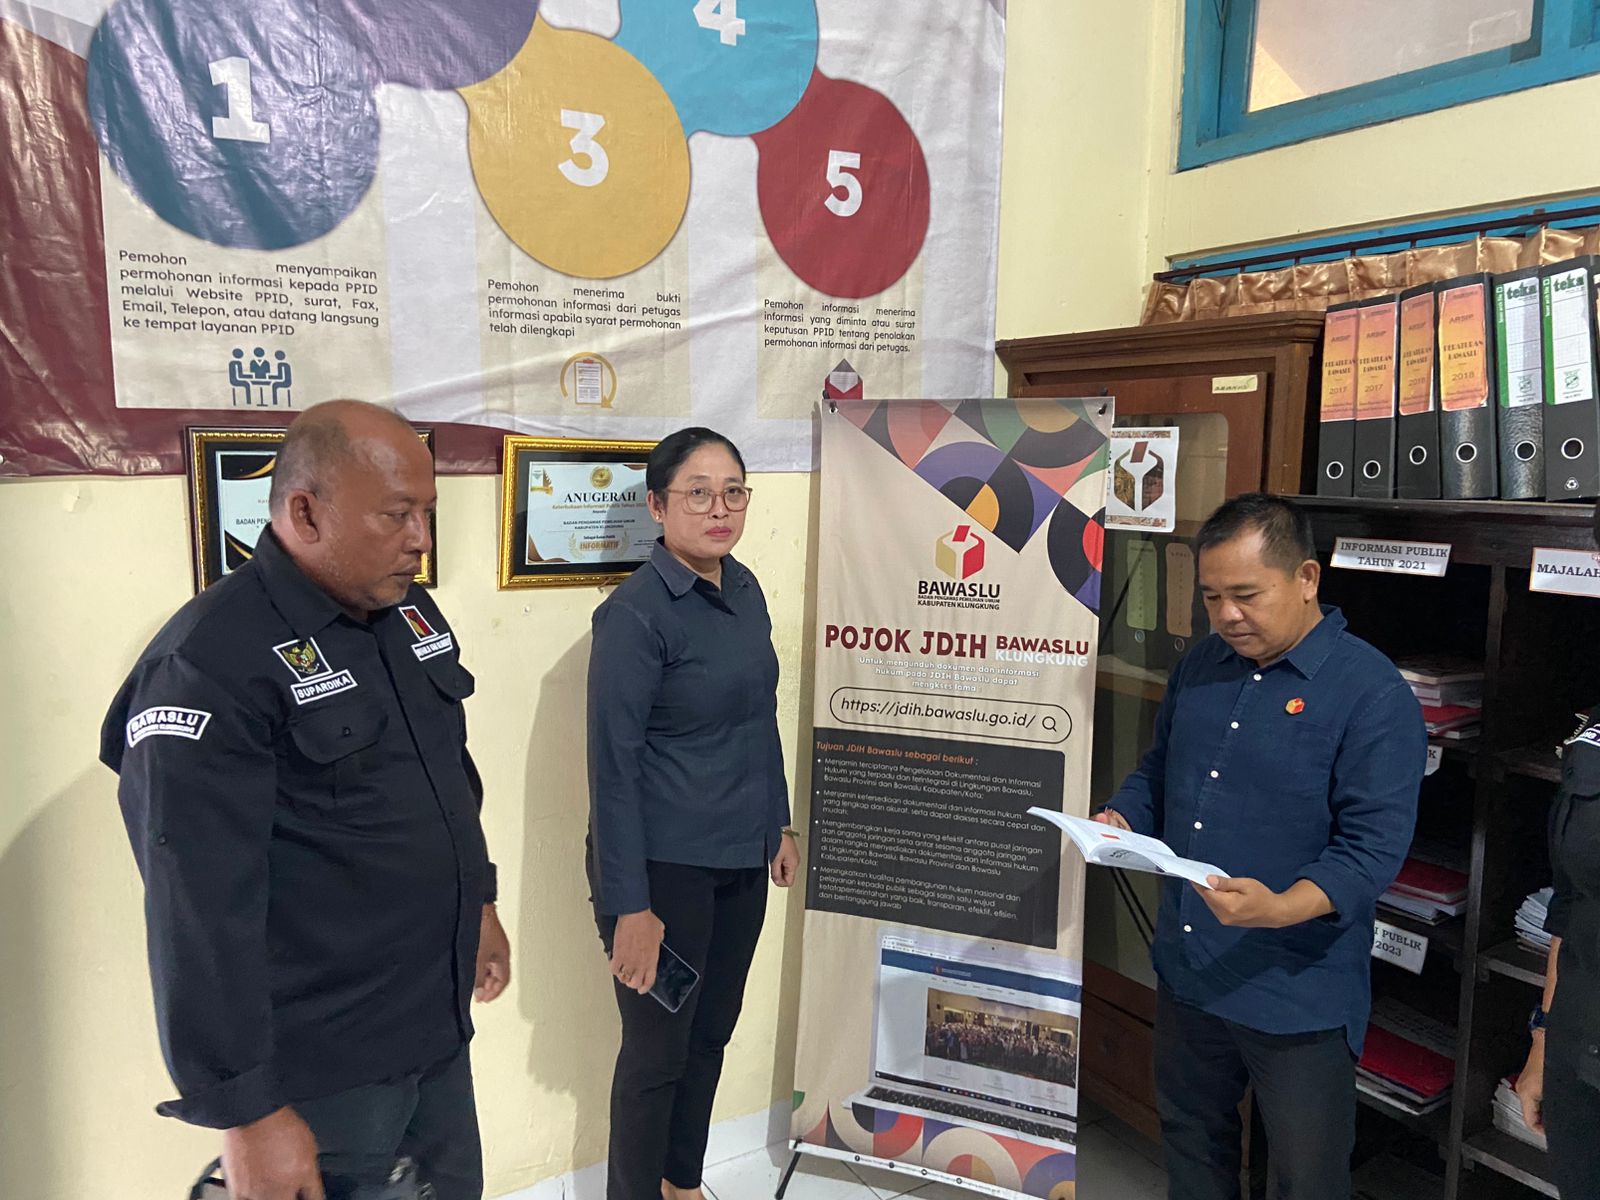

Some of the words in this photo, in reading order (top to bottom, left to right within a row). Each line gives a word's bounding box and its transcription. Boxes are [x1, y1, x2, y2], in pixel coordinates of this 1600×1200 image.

[693, 0, 746, 46] 4
[208, 56, 271, 143] 1
[557, 108, 609, 187] 3
[824, 149, 863, 217] 5
[118, 249, 186, 264] Pemohon
[276, 263, 376, 279] menyampaikan
[120, 269, 212, 282] permohonan
[218, 272, 282, 288] informasi
[288, 278, 338, 293] kepada
[346, 281, 378, 294] PPID
[486, 278, 540, 292] Pemohon
[572, 287, 624, 298] menerima
[656, 291, 680, 302] bukti
[1507, 283, 1538, 300] teka
[1554, 274, 1584, 292] teka
[120, 284, 173, 296] melalui
[186, 287, 242, 301] Website
[254, 291, 292, 306] PPID,
[304, 296, 341, 309] surat,
[352, 297, 378, 311] Fax,
[487, 295, 558, 307] permohonan
[562, 297, 610, 311] informasi
[616, 302, 636, 313] dari
[640, 305, 680, 318] petugas
[764, 298, 804, 309] Pemohon
[820, 301, 860, 313] informasi
[874, 306, 916, 316] menerima
[122, 299, 166, 315] Email,
[170, 302, 230, 319] Telepon,
[234, 308, 264, 318] atau
[268, 307, 316, 323] datang
[320, 310, 378, 327] langsung
[488, 307, 540, 319] informasi
[542, 311, 582, 324] apabila
[584, 315, 616, 326] syarat
[618, 317, 680, 328] permohonan
[764, 310, 804, 322] informasi
[809, 315, 830, 326] yang
[836, 315, 866, 325] diminta
[870, 318, 890, 327] atau
[894, 320, 916, 328] surat
[122, 316, 140, 327] ke
[144, 319, 196, 333] tempat
[200, 320, 256, 335] layanan
[260, 323, 294, 335] PPID
[489, 321, 516, 332] telah
[519, 323, 574, 339] dilengkapi
[764, 323, 808, 336] keputusan
[812, 326, 834, 336] PPID
[838, 328, 870, 341] tentang
[874, 330, 916, 341] penolakan
[764, 337, 818, 348] permohonan
[820, 339, 856, 349] informasi
[858, 341, 874, 350] dari
[876, 343, 910, 354] petugas.
[1452, 370, 1475, 381] 2018
[564, 491, 635, 504] ANUGERAH
[1341, 542, 1402, 555] INFORMASI
[1406, 546, 1449, 558] PUBLIK
[1358, 557, 1394, 568] TAHUN
[1398, 559, 1426, 570] 2021
[918, 580, 1000, 598] BAWASLU
[917, 599, 956, 607] KABUPATEN
[956, 601, 1000, 609] KLUNGKUNG
[825, 624, 911, 652] POJOK
[920, 631, 987, 659] JDIH
[995, 635, 1088, 655] BAWASLU
[858, 656, 882, 665] Untuk
[886, 659, 934, 669] mengunduh
[936, 661, 976, 672] dokumen
[978, 665, 995, 673] dan
[996, 666, 1040, 677] informasi
[995, 650, 1088, 668] KLUNGKUNG
[296, 675, 350, 698] SUPARDIKA
[874, 666, 904, 676] hukum
[906, 669, 926, 678] pada
[930, 670, 952, 680] JDIH
[954, 672, 990, 682] Bawaslu
[992, 675, 1018, 686] dapat
[131, 711, 199, 733] BAWASLU
[841, 697, 1037, 728] https://jdih.bawaslu.go.id/
[816, 740, 844, 751] Tujuan
[846, 743, 864, 752] JDIH
[866, 745, 902, 756] Bawaslu
[904, 750, 940, 761] sebagai
[942, 753, 973, 764] berikut
[824, 756, 858, 768] Menjamin
[858, 761, 898, 773] terciptanya
[900, 765, 942, 776] Pengelolaan
[944, 770, 990, 782] Dokumentasi
[991, 775, 1006, 784] dan
[1008, 777, 1040, 787] Informasi
[824, 765, 846, 774] Hukum
[848, 769, 866, 778] yang
[866, 770, 894, 780] terpadu
[896, 772, 910, 781] dan
[912, 775, 949, 786] terintegrasi
[950, 778, 958, 786] di
[958, 779, 1000, 793] Lingkungan
[1002, 785, 1034, 798] Bawaslu,
[823, 773, 850, 783] Bawaslu
[852, 776, 876, 785] Provinsi
[878, 779, 892, 787] dan
[893, 780, 920, 790] Bawaslu
[922, 784, 984, 801] Kabupaten/Kota;
[822, 788, 856, 799] Menjamin
[856, 792, 900, 804] ketersediaan
[902, 797, 946, 809] dokumentasi
[948, 802, 962, 811] dan
[964, 804, 996, 815] informasi
[996, 809, 1022, 819] hukum
[822, 798, 840, 808] yang
[841, 798, 868, 811] lengkap
[870, 802, 884, 810] dan
[886, 804, 910, 816] akurat,
[930, 809, 951, 820] dapat
[952, 812, 978, 822] diakses
[980, 817, 1004, 826] secara
[1006, 821, 1028, 830] cepat
[1030, 822, 1046, 831] dan
[1375, 941, 1402, 957] 2023
[1382, 929, 1422, 950] PUBLIK
